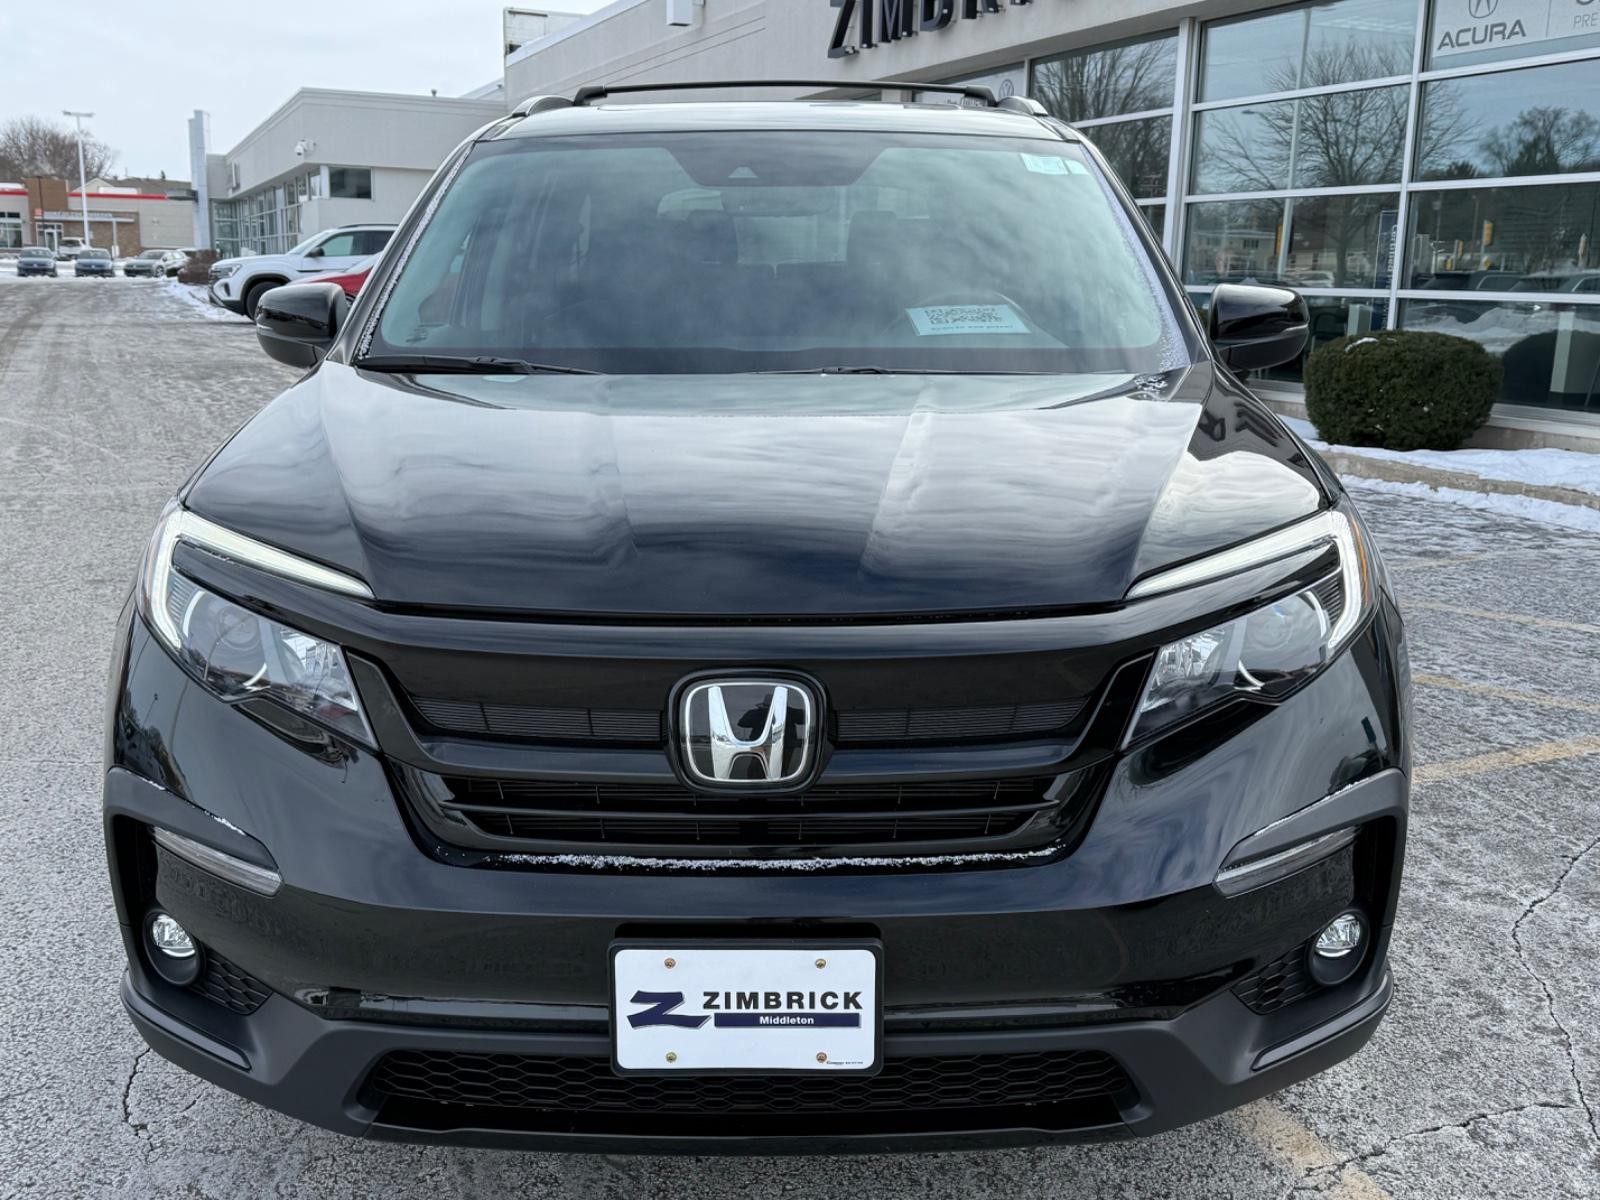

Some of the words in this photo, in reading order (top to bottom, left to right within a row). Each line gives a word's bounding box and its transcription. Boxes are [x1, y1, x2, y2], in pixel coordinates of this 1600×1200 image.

[828, 0, 1031, 58] ZIMB
[1437, 19, 1526, 50] ACURA
[702, 991, 863, 1010] ZIMBRICK
[759, 1015, 815, 1026] Middleton
